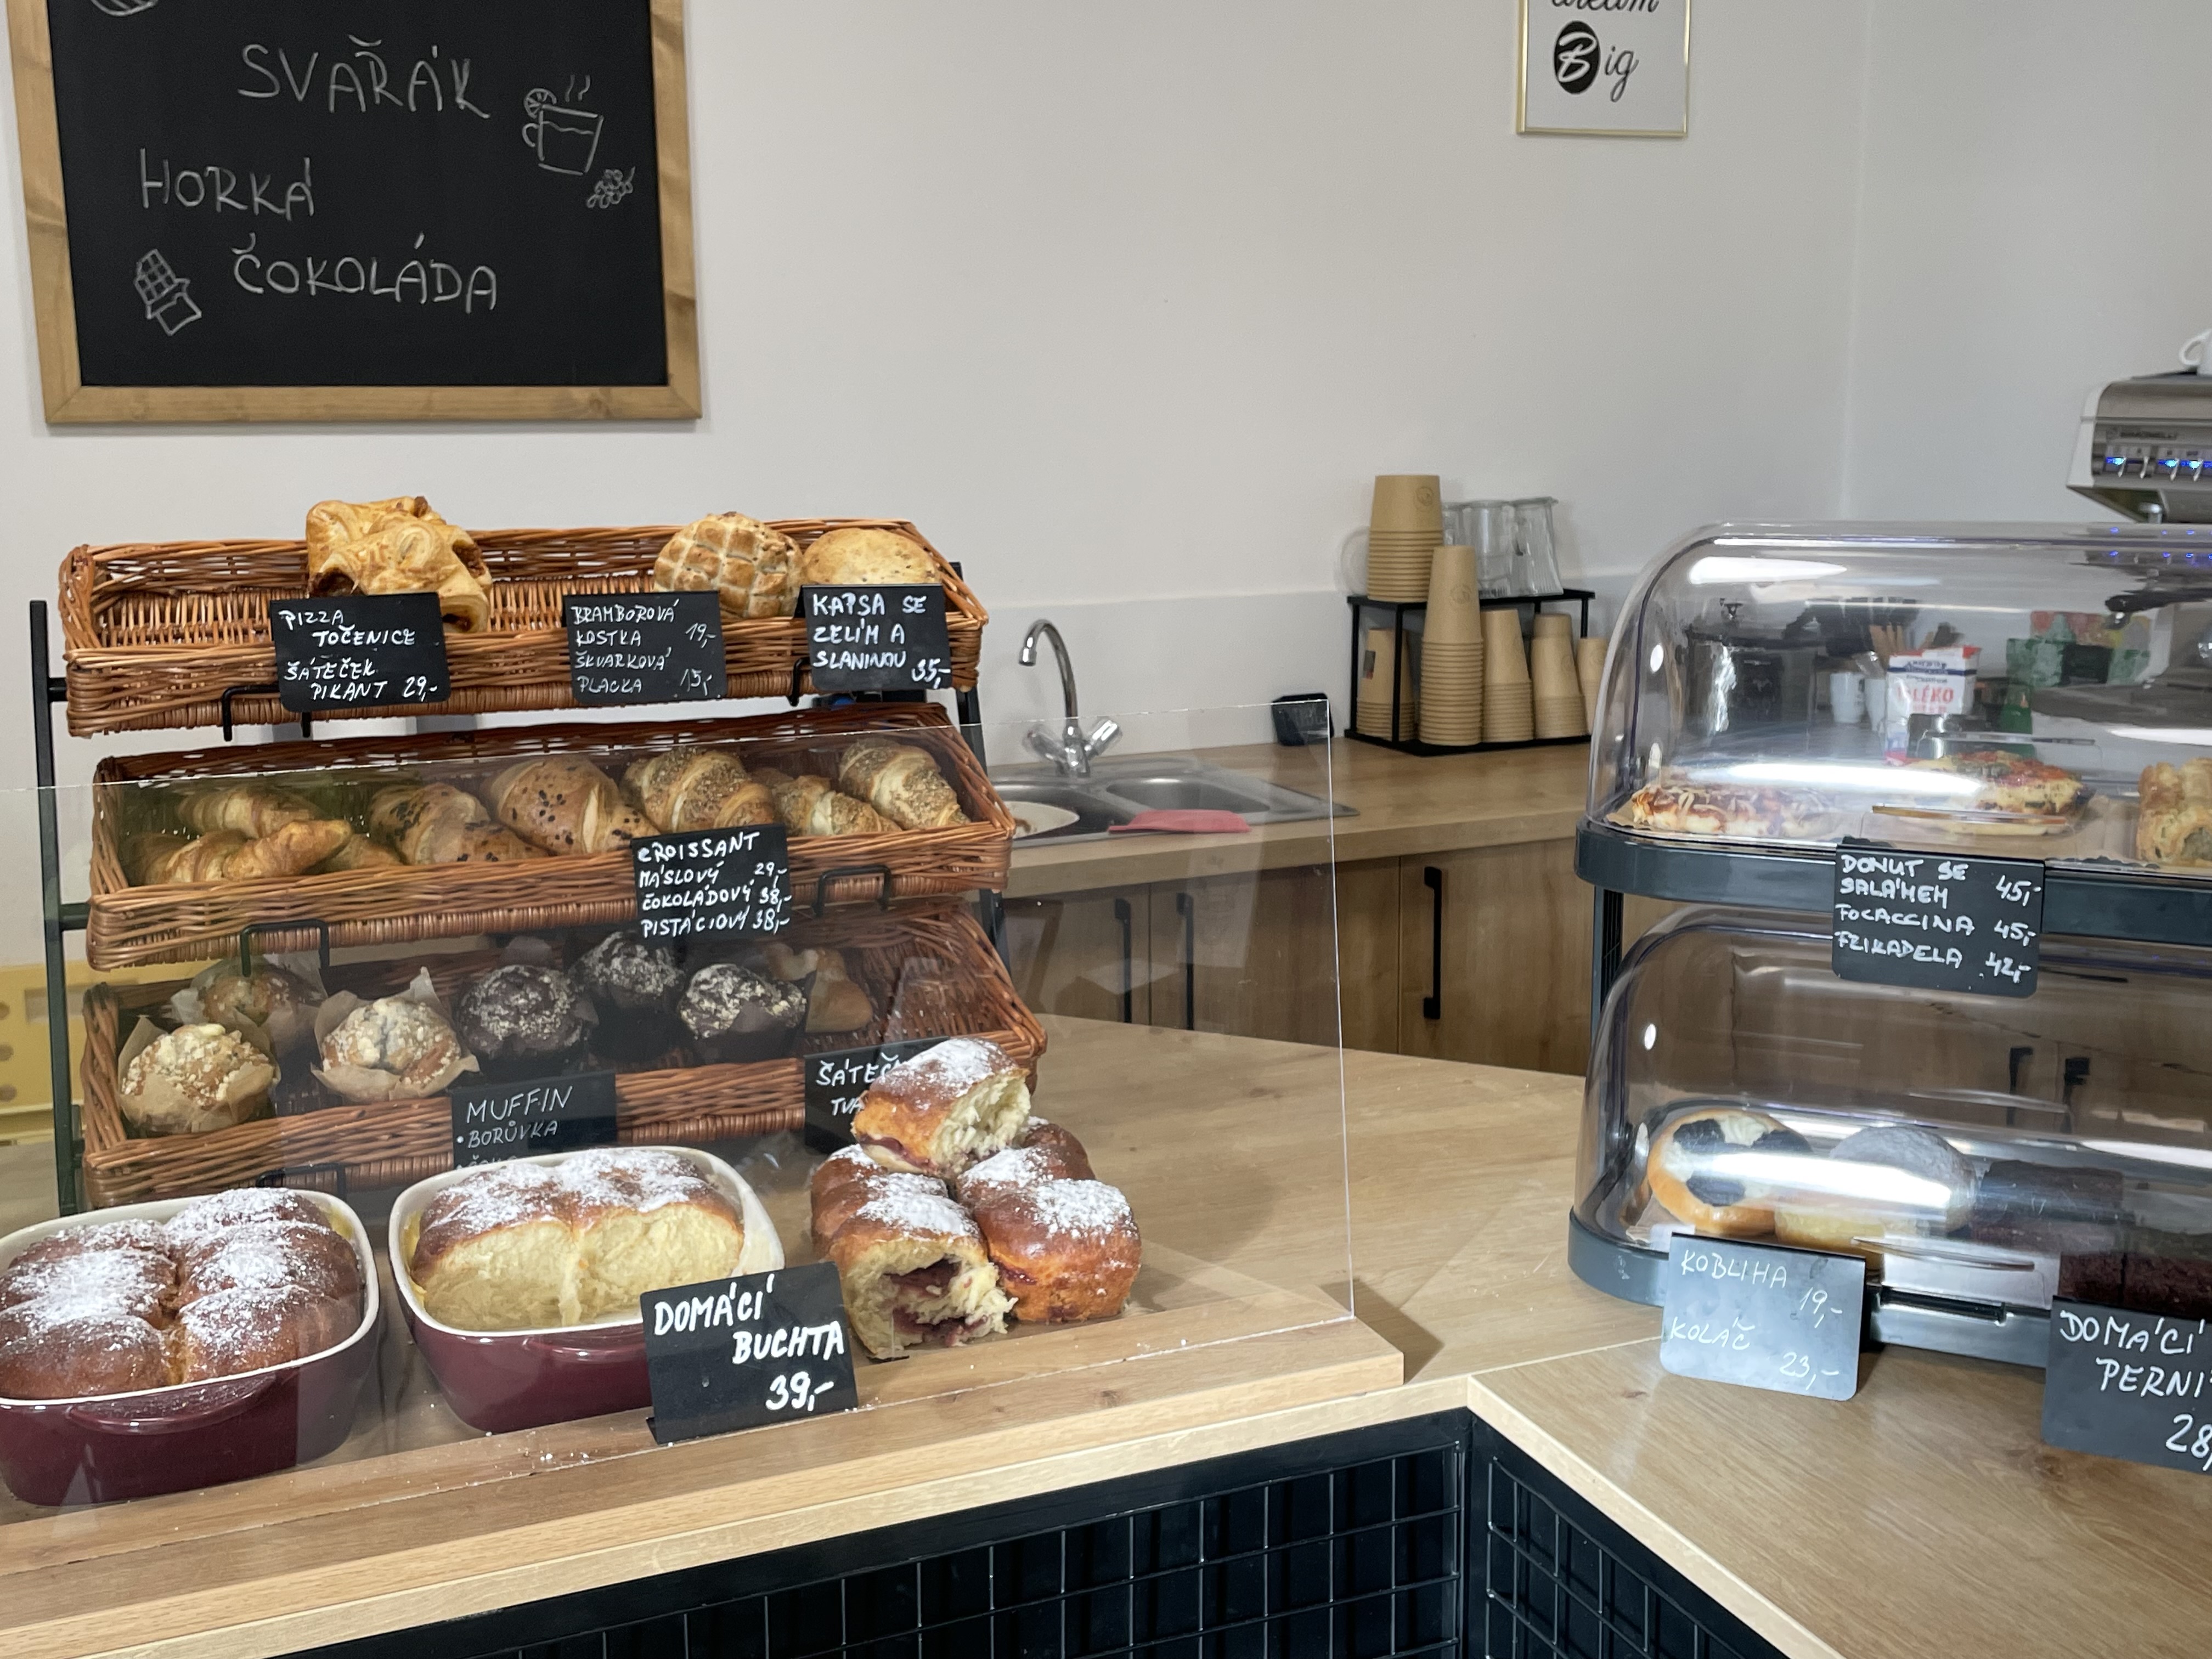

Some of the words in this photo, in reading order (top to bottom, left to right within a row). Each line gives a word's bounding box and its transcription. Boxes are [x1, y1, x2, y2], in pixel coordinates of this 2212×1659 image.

[238, 35, 490, 118] SVAŘÁK
[1555, 22, 1639, 102] Big
[139, 148, 314, 221] HORKÁ
[230, 233, 496, 313] ČOKOLÁDA
[279, 609, 343, 630] PIZZA
[571, 598, 680, 625] BRAMBOROVÁ
[812, 592, 885, 617] KAPSA
[902, 595, 927, 614] SE
[312, 624, 415, 647] TOČENICE
[576, 630, 641, 647] KOSTKA
[685, 623, 716, 648] 19,-
[813, 617, 879, 645] ZELÍM
[890, 623, 905, 645] A
[284, 657, 375, 681] ŠÁTEČEK
[575, 647, 672, 671] ŠKVARKOVÁ
[812, 650, 907, 670] SLANINOU
[911, 658, 951, 689] 35,-
[311, 681, 388, 702] PIKANT
[402, 676, 438, 702] 29,-
[577, 676, 642, 693] PLACKA
[637, 831, 760, 862] CROISSANT
[639, 861, 724, 888] MÁSLOVÝ
[754, 861, 788, 888] 29,-
[1841, 854, 1924, 878] DONUT
[1938, 860, 1969, 881] SE
[641, 879, 755, 911] ČOKOLÁDOVÝ
[1995, 874, 2041, 907] 45,-
[641, 905, 751, 938] PISTÁCIOVÝ
[752, 907, 790, 935] 38,-
[1835, 903, 1975, 936] FOCACCINA
[1994, 919, 2036, 946] 45,-
[1985, 951, 2032, 984] 42,-
[816, 1052, 902, 1086] ŠÁTEČ
[466, 1085, 573, 1124] MUFFIN
[468, 1120, 558, 1148] BORŮVKA
[1681, 1249, 1787, 1289] KOBLIHA
[653, 1273, 775, 1335] DOMÁCÍ
[1799, 1286, 1843, 1328] 19,-
[732, 1320, 845, 1365] BUCHTA
[1669, 1316, 1756, 1351] KOLÁČ
[2059, 1310, 2205, 1355] DOMÁCÍ
[1779, 1351, 1839, 1391] 23,-
[765, 1371, 834, 1412] 39,-
